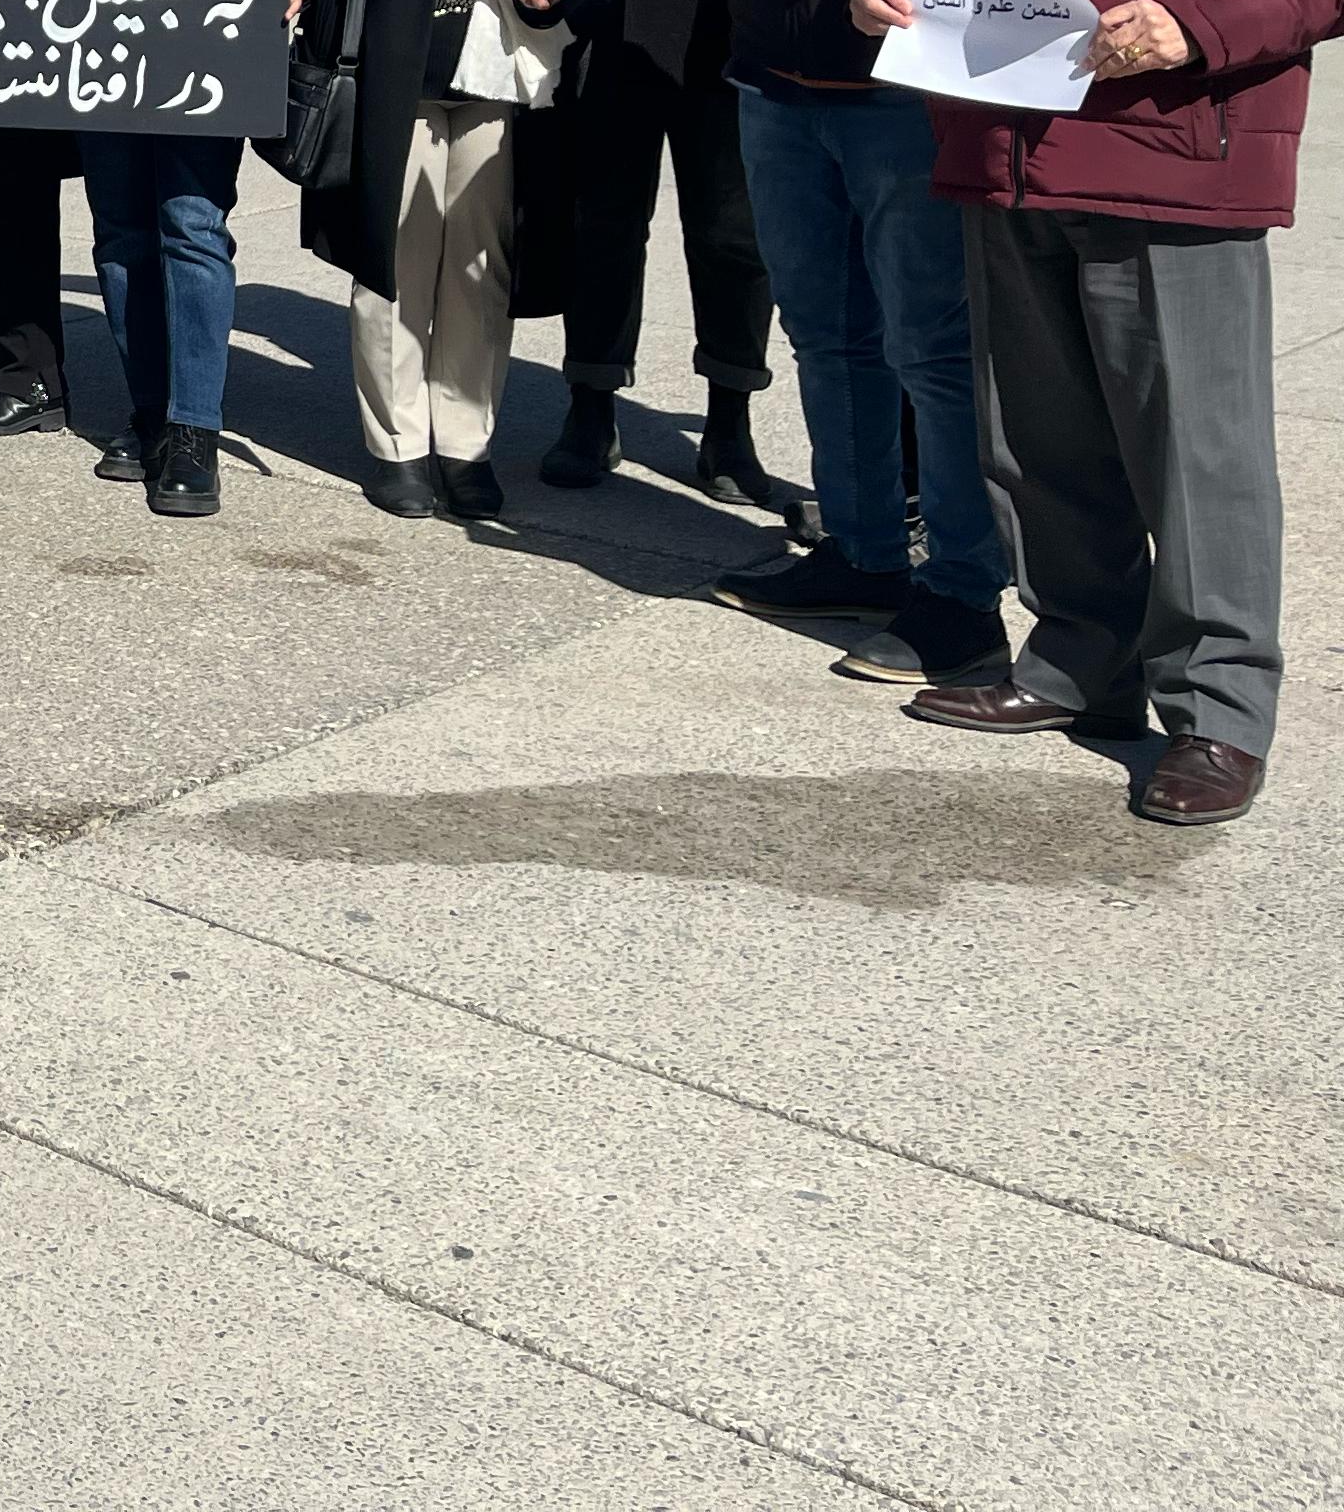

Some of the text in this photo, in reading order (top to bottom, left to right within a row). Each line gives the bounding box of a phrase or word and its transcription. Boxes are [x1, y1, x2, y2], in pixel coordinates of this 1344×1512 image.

[974, 1, 983, 14] و
[1022, 1, 1071, 20] دشمن
[156, 71, 224, 115] در
